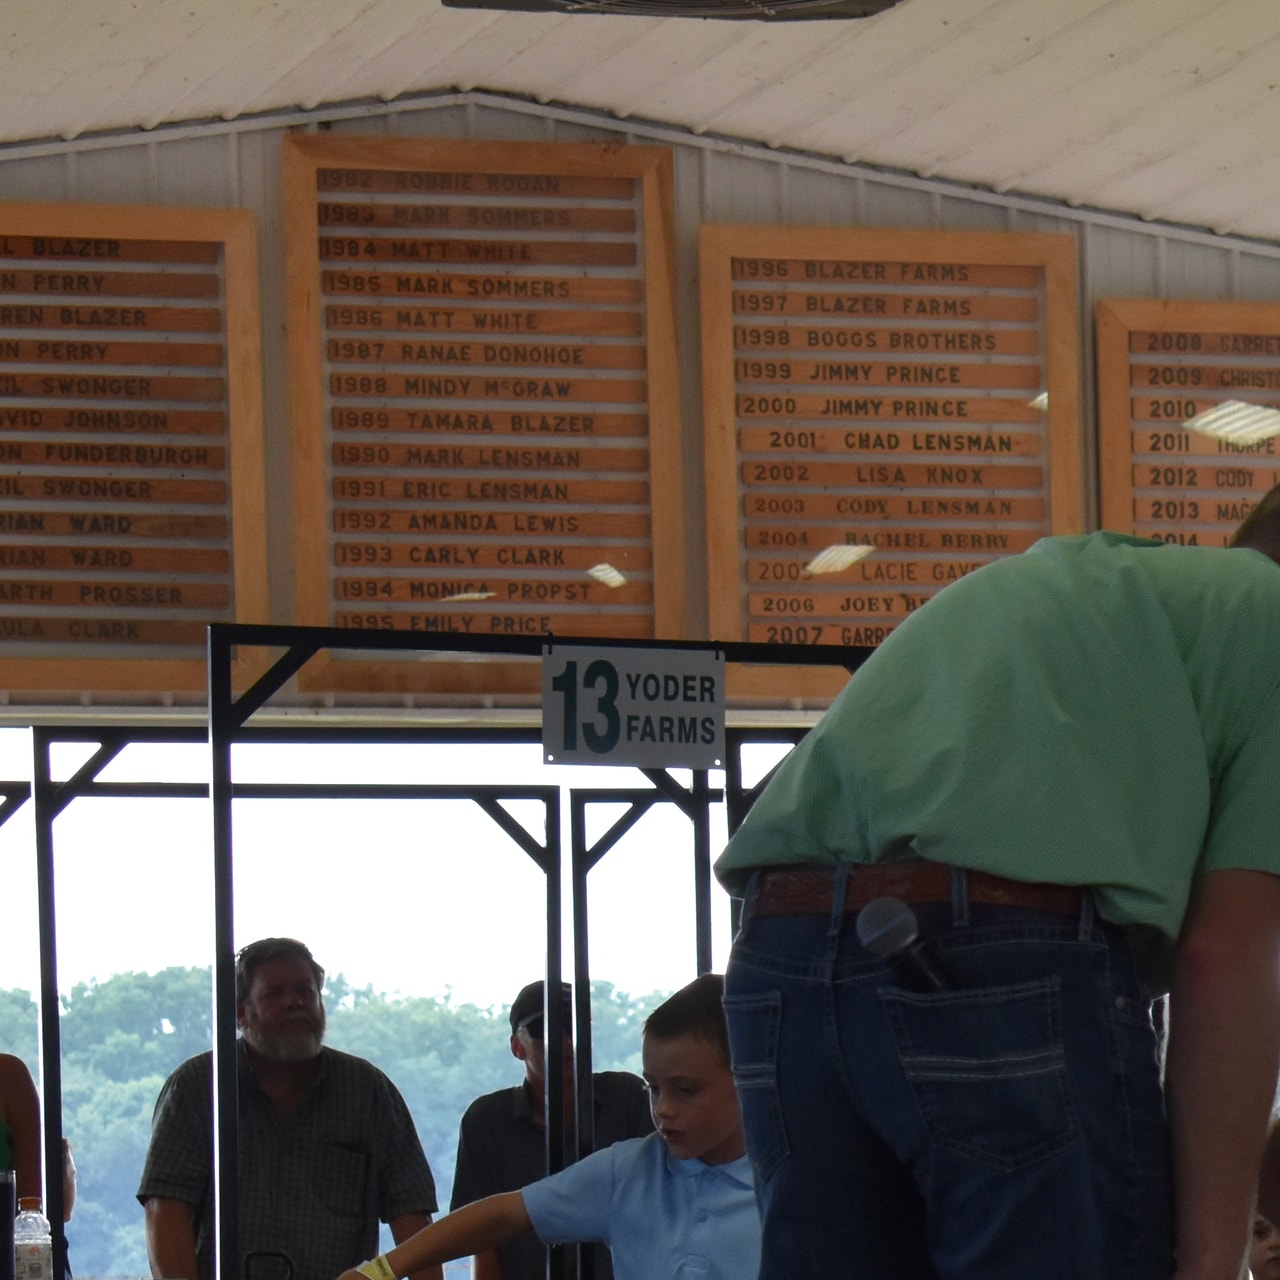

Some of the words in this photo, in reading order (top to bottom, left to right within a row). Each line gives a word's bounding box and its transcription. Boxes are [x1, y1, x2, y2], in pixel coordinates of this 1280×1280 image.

[323, 205, 375, 222] 1983
[393, 207, 450, 224] MARK
[467, 208, 570, 226] SOMMERS
[33, 240, 120, 257] BLAZER
[324, 240, 376, 257] 1984
[392, 241, 450, 259] MATT
[466, 243, 531, 260] WHITE
[738, 261, 789, 277] 1996
[805, 263, 886, 280] BLAZER
[901, 264, 969, 282] FARMS
[34, 274, 104, 291] PERRY
[329, 275, 381, 292] 1985
[396, 277, 453, 295] MARK
[467, 279, 570, 297] SOMMERS
[739, 295, 788, 312] 1997
[805, 296, 887, 313] BLAZER
[902, 299, 971, 316] FARMS
[60, 308, 147, 326] BLAZER
[331, 309, 382, 326] 1986
[396, 311, 455, 328] MATT
[472, 313, 537, 330] WHITE
[740, 329, 790, 345] 1998
[807, 330, 877, 347] BOGGS
[889, 332, 997, 351] BROTHERS
[1147, 333, 1202, 351] 2008
[37, 343, 108, 360] PERRY
[334, 343, 385, 359] 1987
[401, 345, 471, 362] RANAE
[484, 346, 585, 364] DONOHOE
[742, 362, 792, 379] 1999
[809, 364, 873, 381] JIMMY
[885, 366, 960, 384] PRINCE
[1148, 367, 1202, 386] 2009
[41, 377, 151, 396] SWONGER
[335, 376, 387, 393] 1988
[405, 378, 471, 396] MINDY
[744, 397, 797, 414] 2000
[820, 399, 884, 416] JIMMY
[892, 400, 968, 417] PRINCE
[1150, 400, 1197, 418] 2010
[64, 410, 168, 429] JOHNSON
[338, 412, 389, 429] 1989
[407, 413, 494, 431] TAMARA
[511, 415, 595, 433] BLAZER
[769, 430, 816, 448] 2001
[844, 433, 900, 451] CHAD
[912, 434, 1012, 453] LENSMAN
[1149, 433, 1190, 452] 2011
[45, 446, 209, 464] FUNDERBURGH
[340, 446, 390, 464] 1990
[407, 448, 464, 466] MARK
[479, 450, 580, 468] LENSMAN
[754, 465, 810, 481] 2002
[857, 467, 906, 484] LISA
[927, 468, 984, 485] KNOX
[1150, 467, 1198, 487] 2012
[1215, 470, 1255, 488] CODY
[43, 480, 152, 498] SWONGER
[340, 480, 386, 497] 1991
[403, 482, 451, 499] ERIC
[466, 482, 568, 500] LENSMAN
[755, 498, 805, 513] 2003
[836, 499, 888, 514] CODY
[907, 499, 1012, 516] LENSMAN
[1151, 500, 1200, 519] 2013
[70, 515, 132, 533] WARD
[340, 513, 392, 530] 1992
[408, 514, 498, 531] AMANDA
[514, 515, 580, 533] LEWIS
[759, 531, 809, 546] 2004
[845, 532, 930, 548] RACHEL
[941, 533, 1010, 549] BERRY
[71, 549, 133, 567] WARD
[340, 546, 393, 563] 1993
[409, 547, 481, 565] CARLY
[496, 548, 566, 566] CLARK
[861, 563, 918, 581] LACIE
[80, 585, 183, 604] PROSSER
[342, 580, 395, 597] 1994
[409, 581, 490, 598] MONICA
[506, 583, 593, 601] PROPST
[763, 597, 815, 613] 2006
[840, 597, 895, 613] JOEY
[68, 621, 140, 638] CLARK
[410, 616, 474, 632] EMILY
[490, 617, 553, 634] PRICE
[766, 626, 823, 643] 2007
[625, 672, 716, 703] YODER
[552, 659, 620, 755] 13
[626, 714, 716, 746] FARMS
